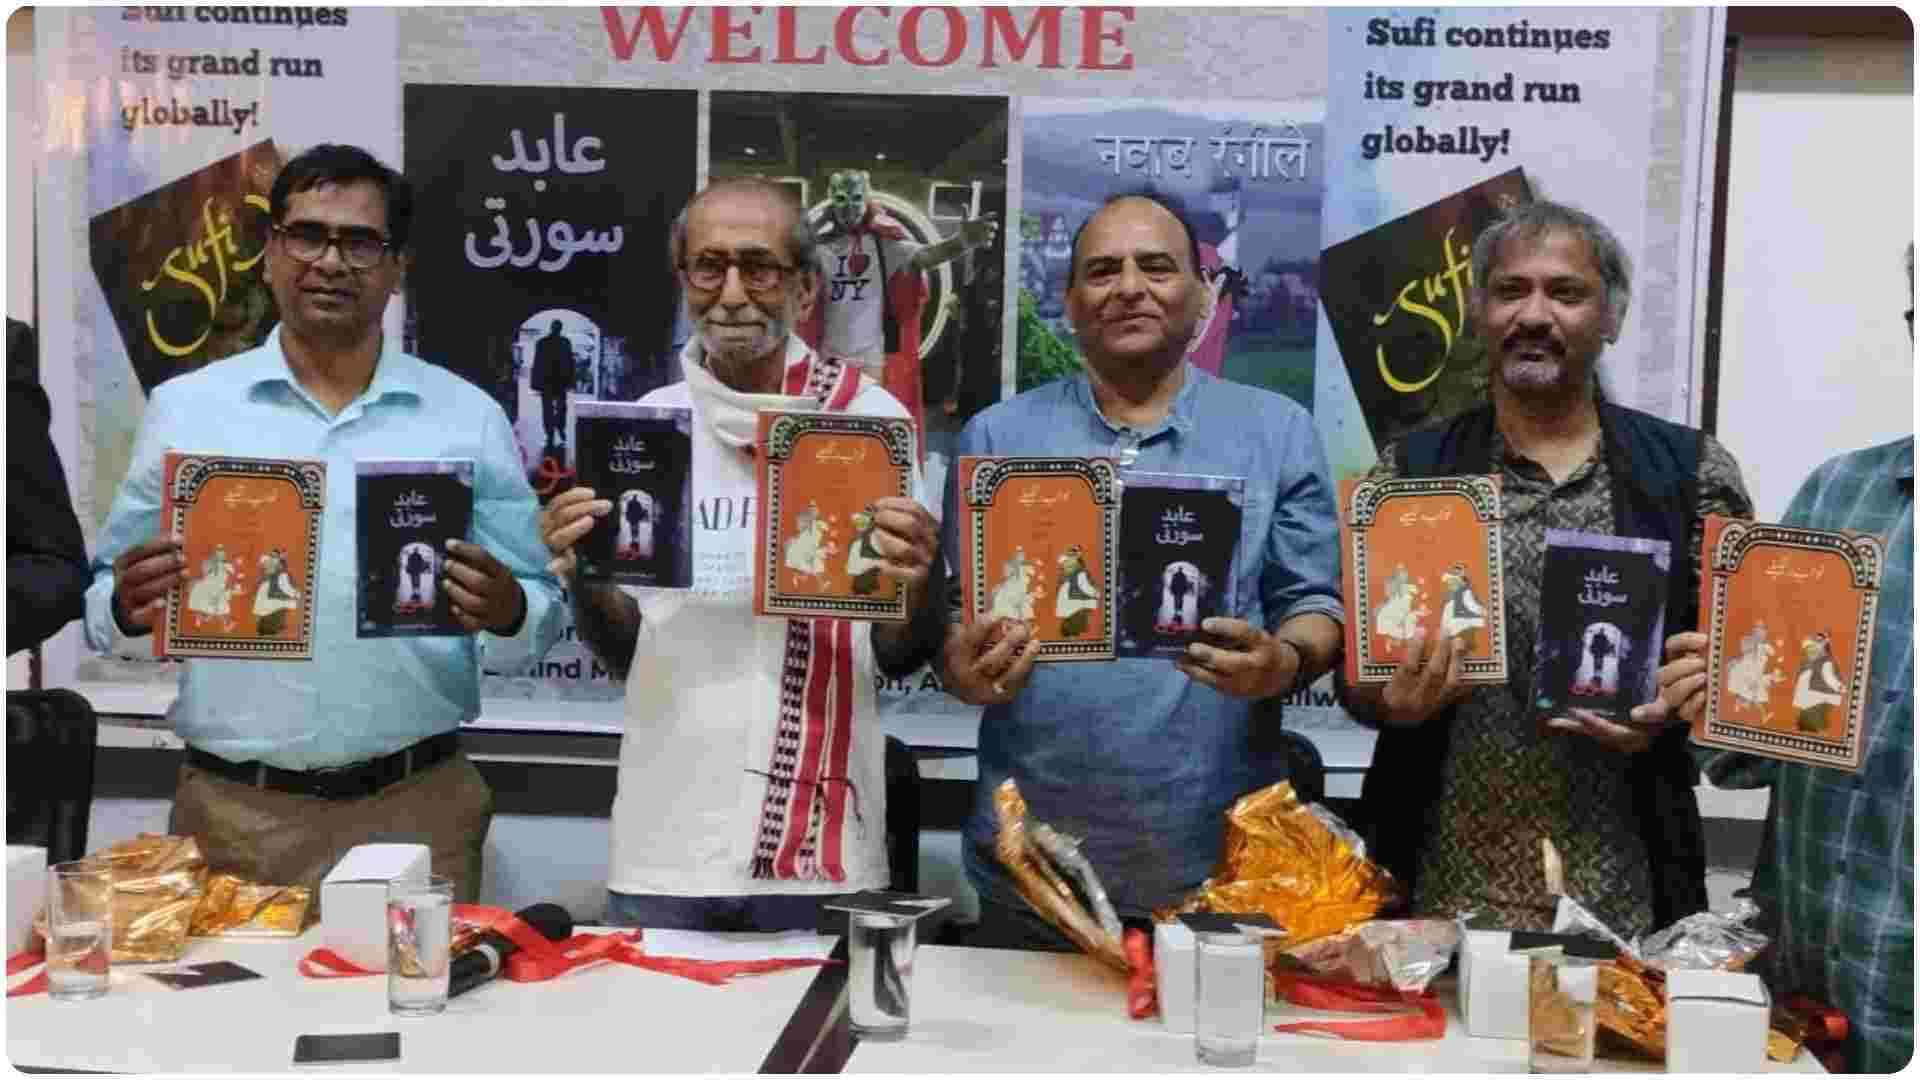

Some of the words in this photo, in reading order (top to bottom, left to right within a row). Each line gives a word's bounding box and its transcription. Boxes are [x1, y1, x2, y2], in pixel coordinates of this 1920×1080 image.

[602, 6, 1136, 70] WELCOME
[1366, 16, 1436, 47] Sufi
[1445, 19, 1611, 54] continues
[121, 46, 157, 74] its
[168, 48, 260, 80] grand
[270, 57, 324, 77] run
[1364, 71, 1404, 100] its
[1413, 72, 1514, 107] grand
[1523, 80, 1581, 103] run
[121, 97, 260, 134] globally!
[492, 112, 606, 192] عابد
[1362, 125, 1511, 163] globally!
